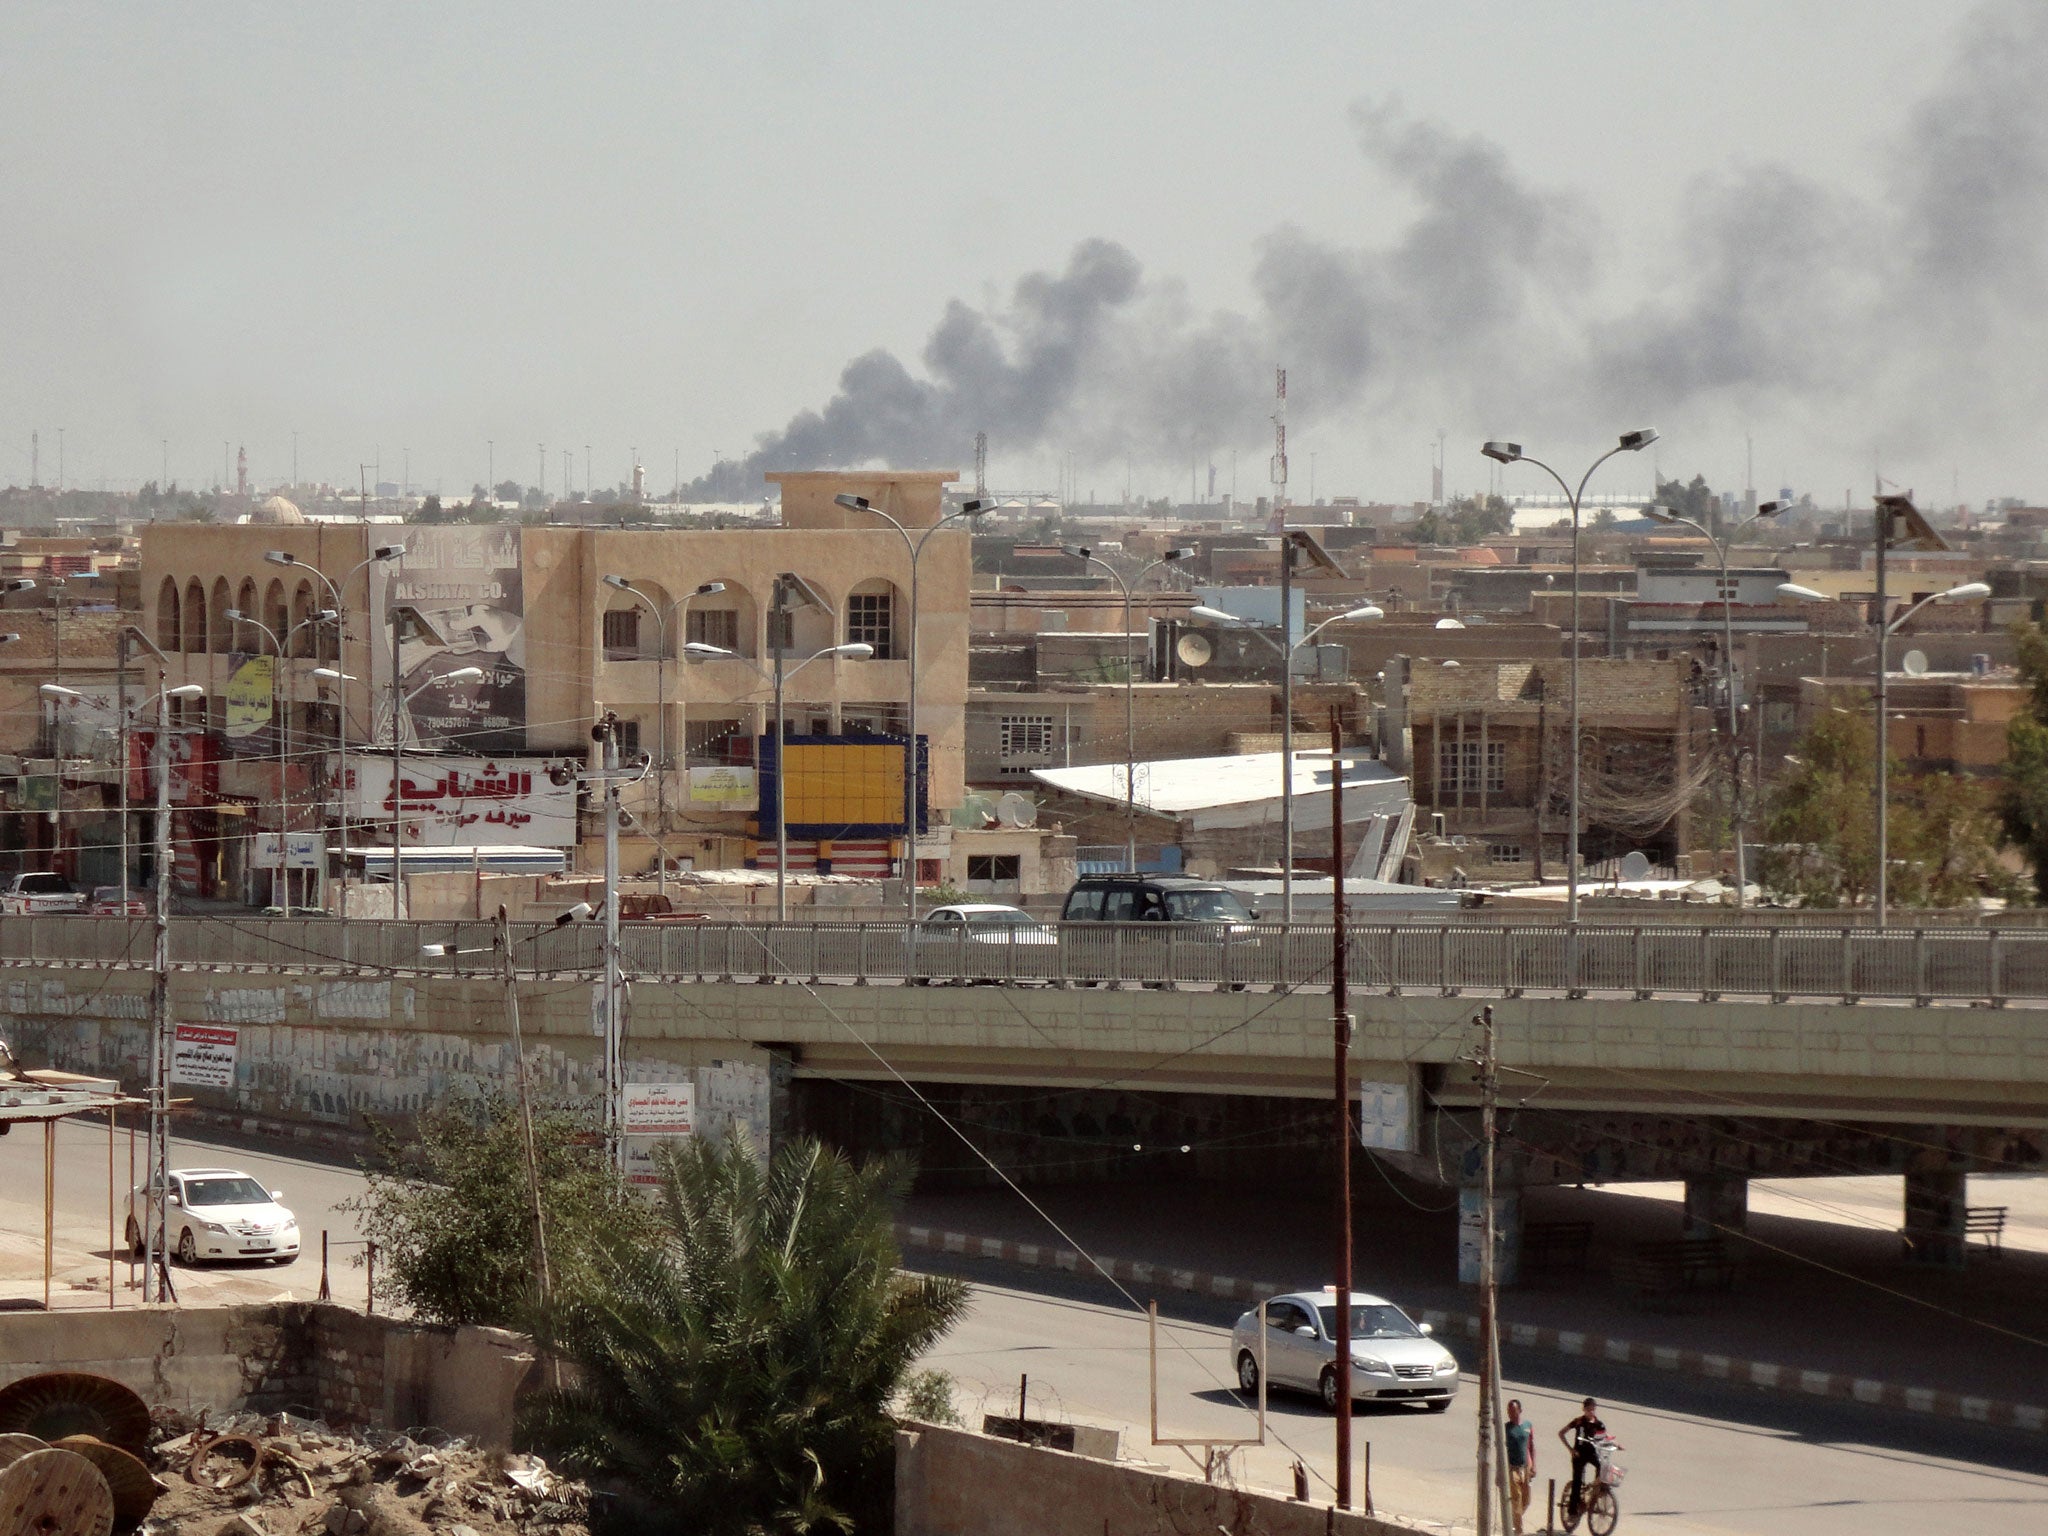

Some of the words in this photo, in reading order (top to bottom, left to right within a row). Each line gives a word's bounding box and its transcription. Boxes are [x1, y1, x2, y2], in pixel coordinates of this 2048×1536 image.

[452, 529, 518, 575] شركة
[395, 582, 470, 600] ALSHAYA
[480, 581, 508, 599] CO.
[448, 694, 492, 714] صيرفة
